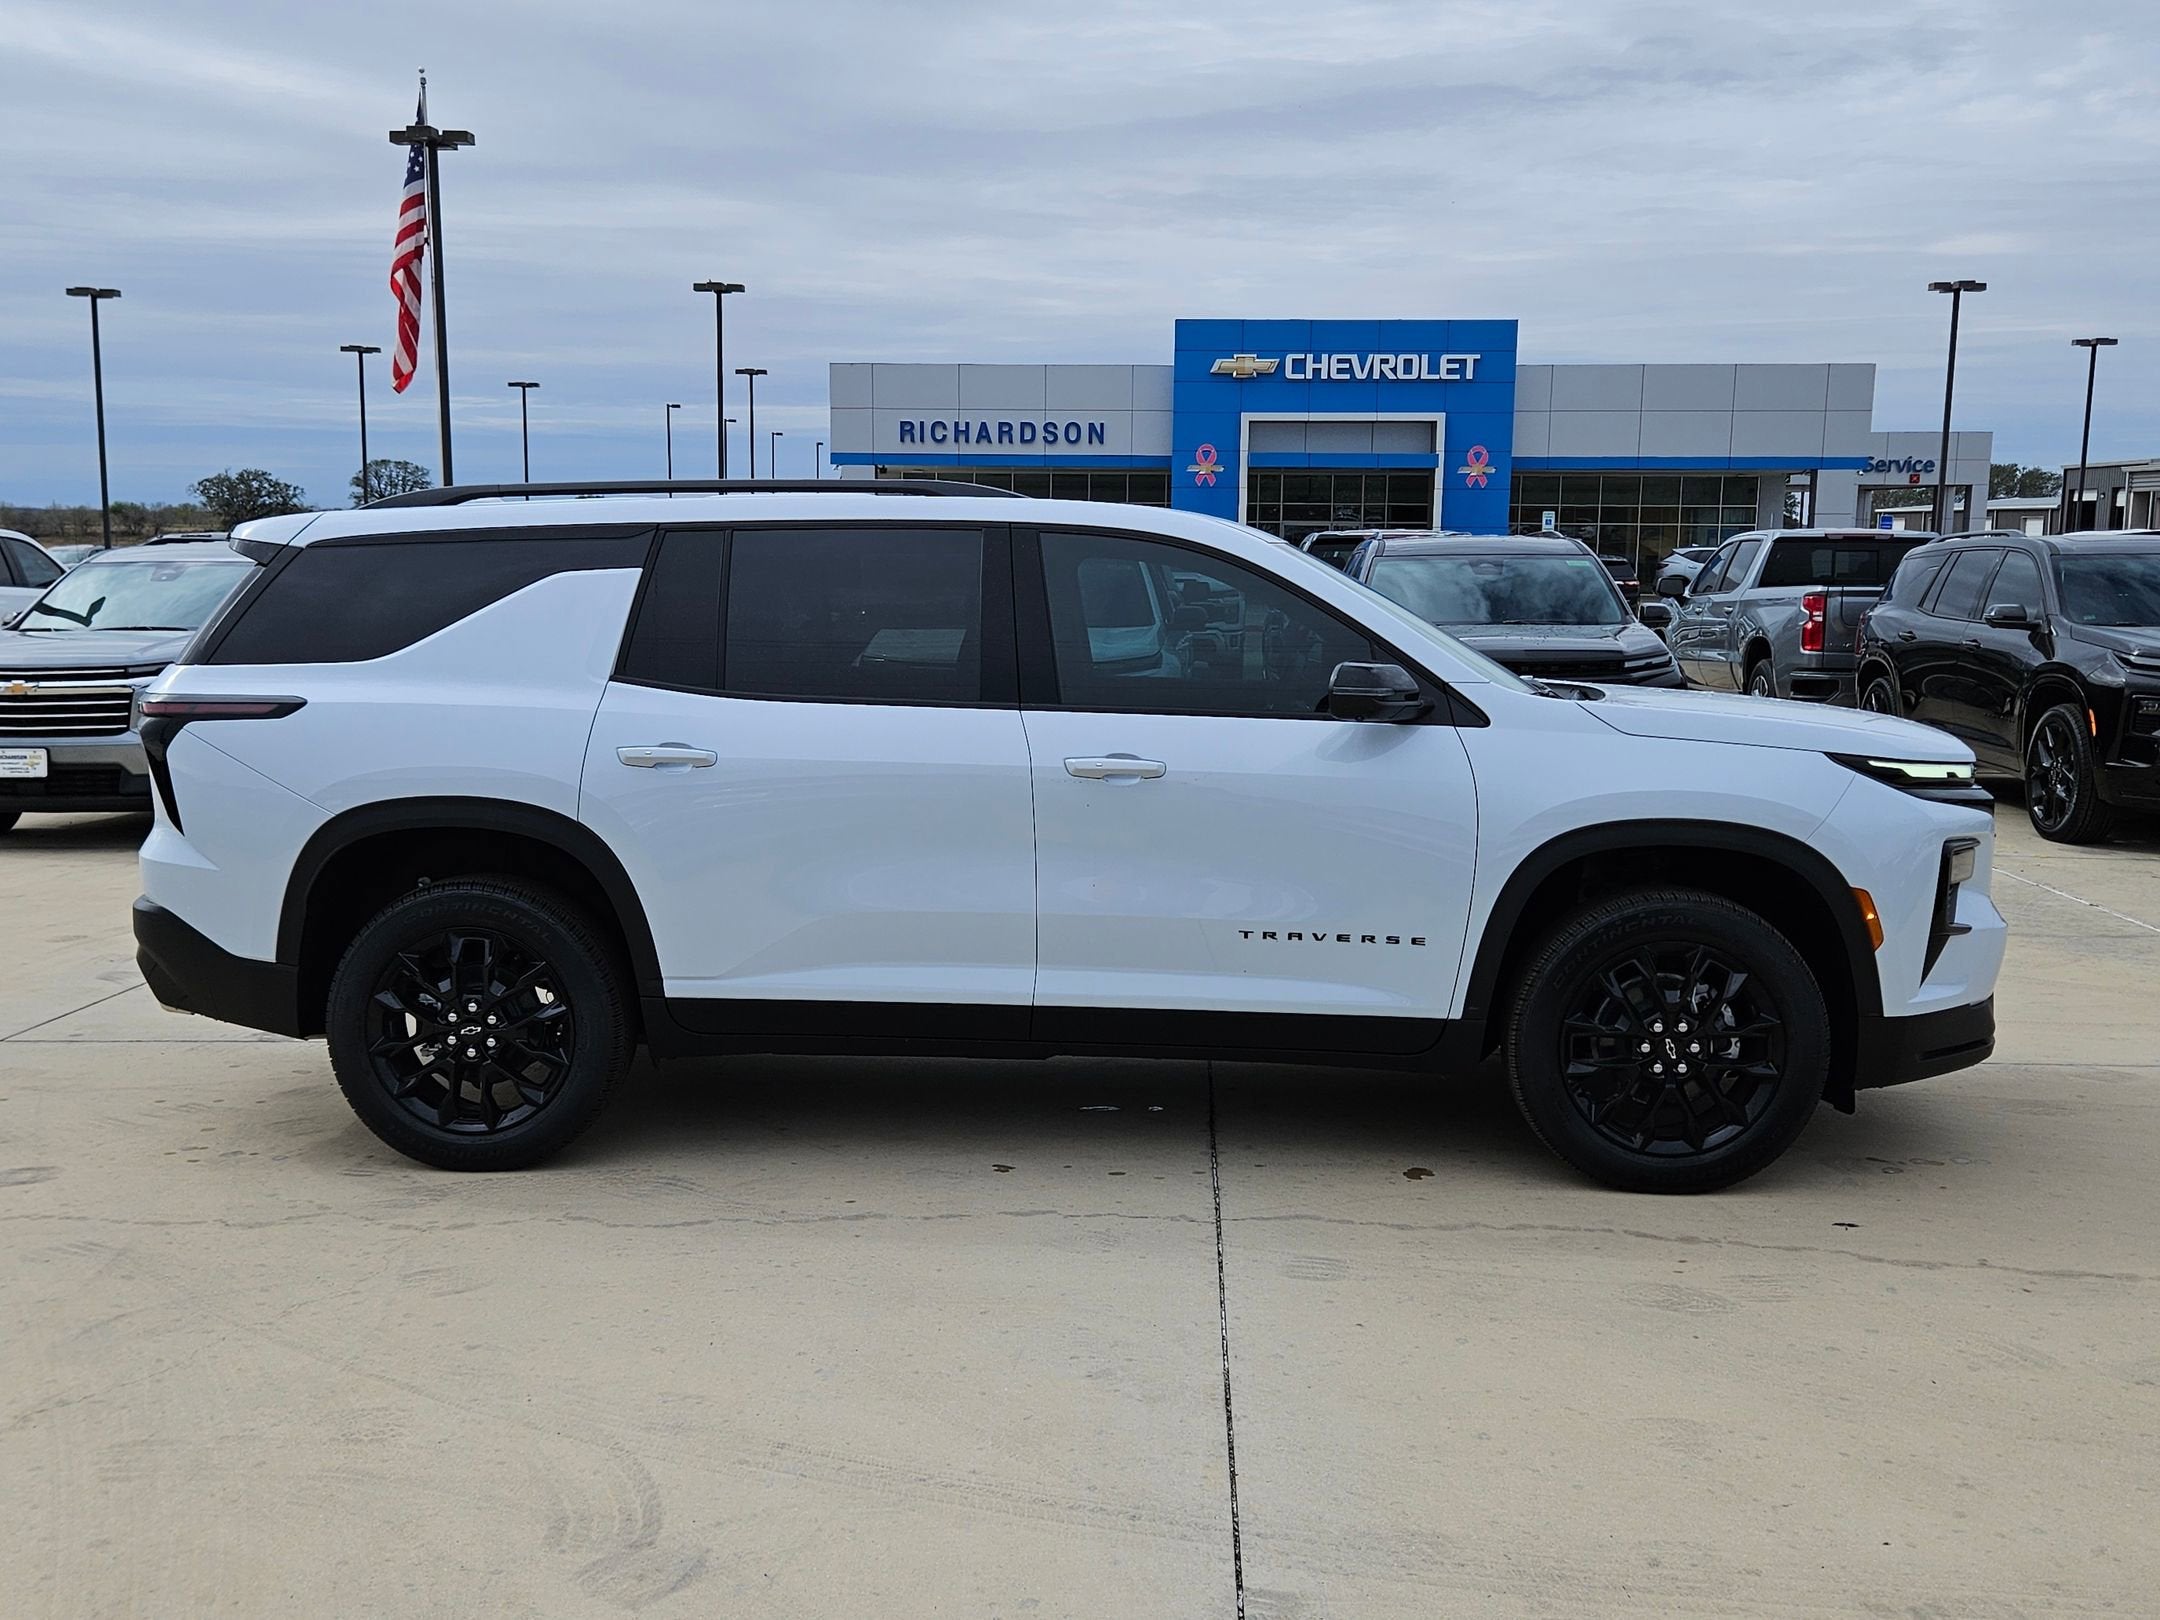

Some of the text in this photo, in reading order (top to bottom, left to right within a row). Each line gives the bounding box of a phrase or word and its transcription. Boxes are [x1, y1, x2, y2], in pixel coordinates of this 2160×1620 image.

[1284, 353, 1481, 381] CHEVROLET
[899, 420, 1105, 446] RICHARDSON
[1862, 456, 1936, 474] Service
[1238, 930, 1427, 947] TRAVERSE
